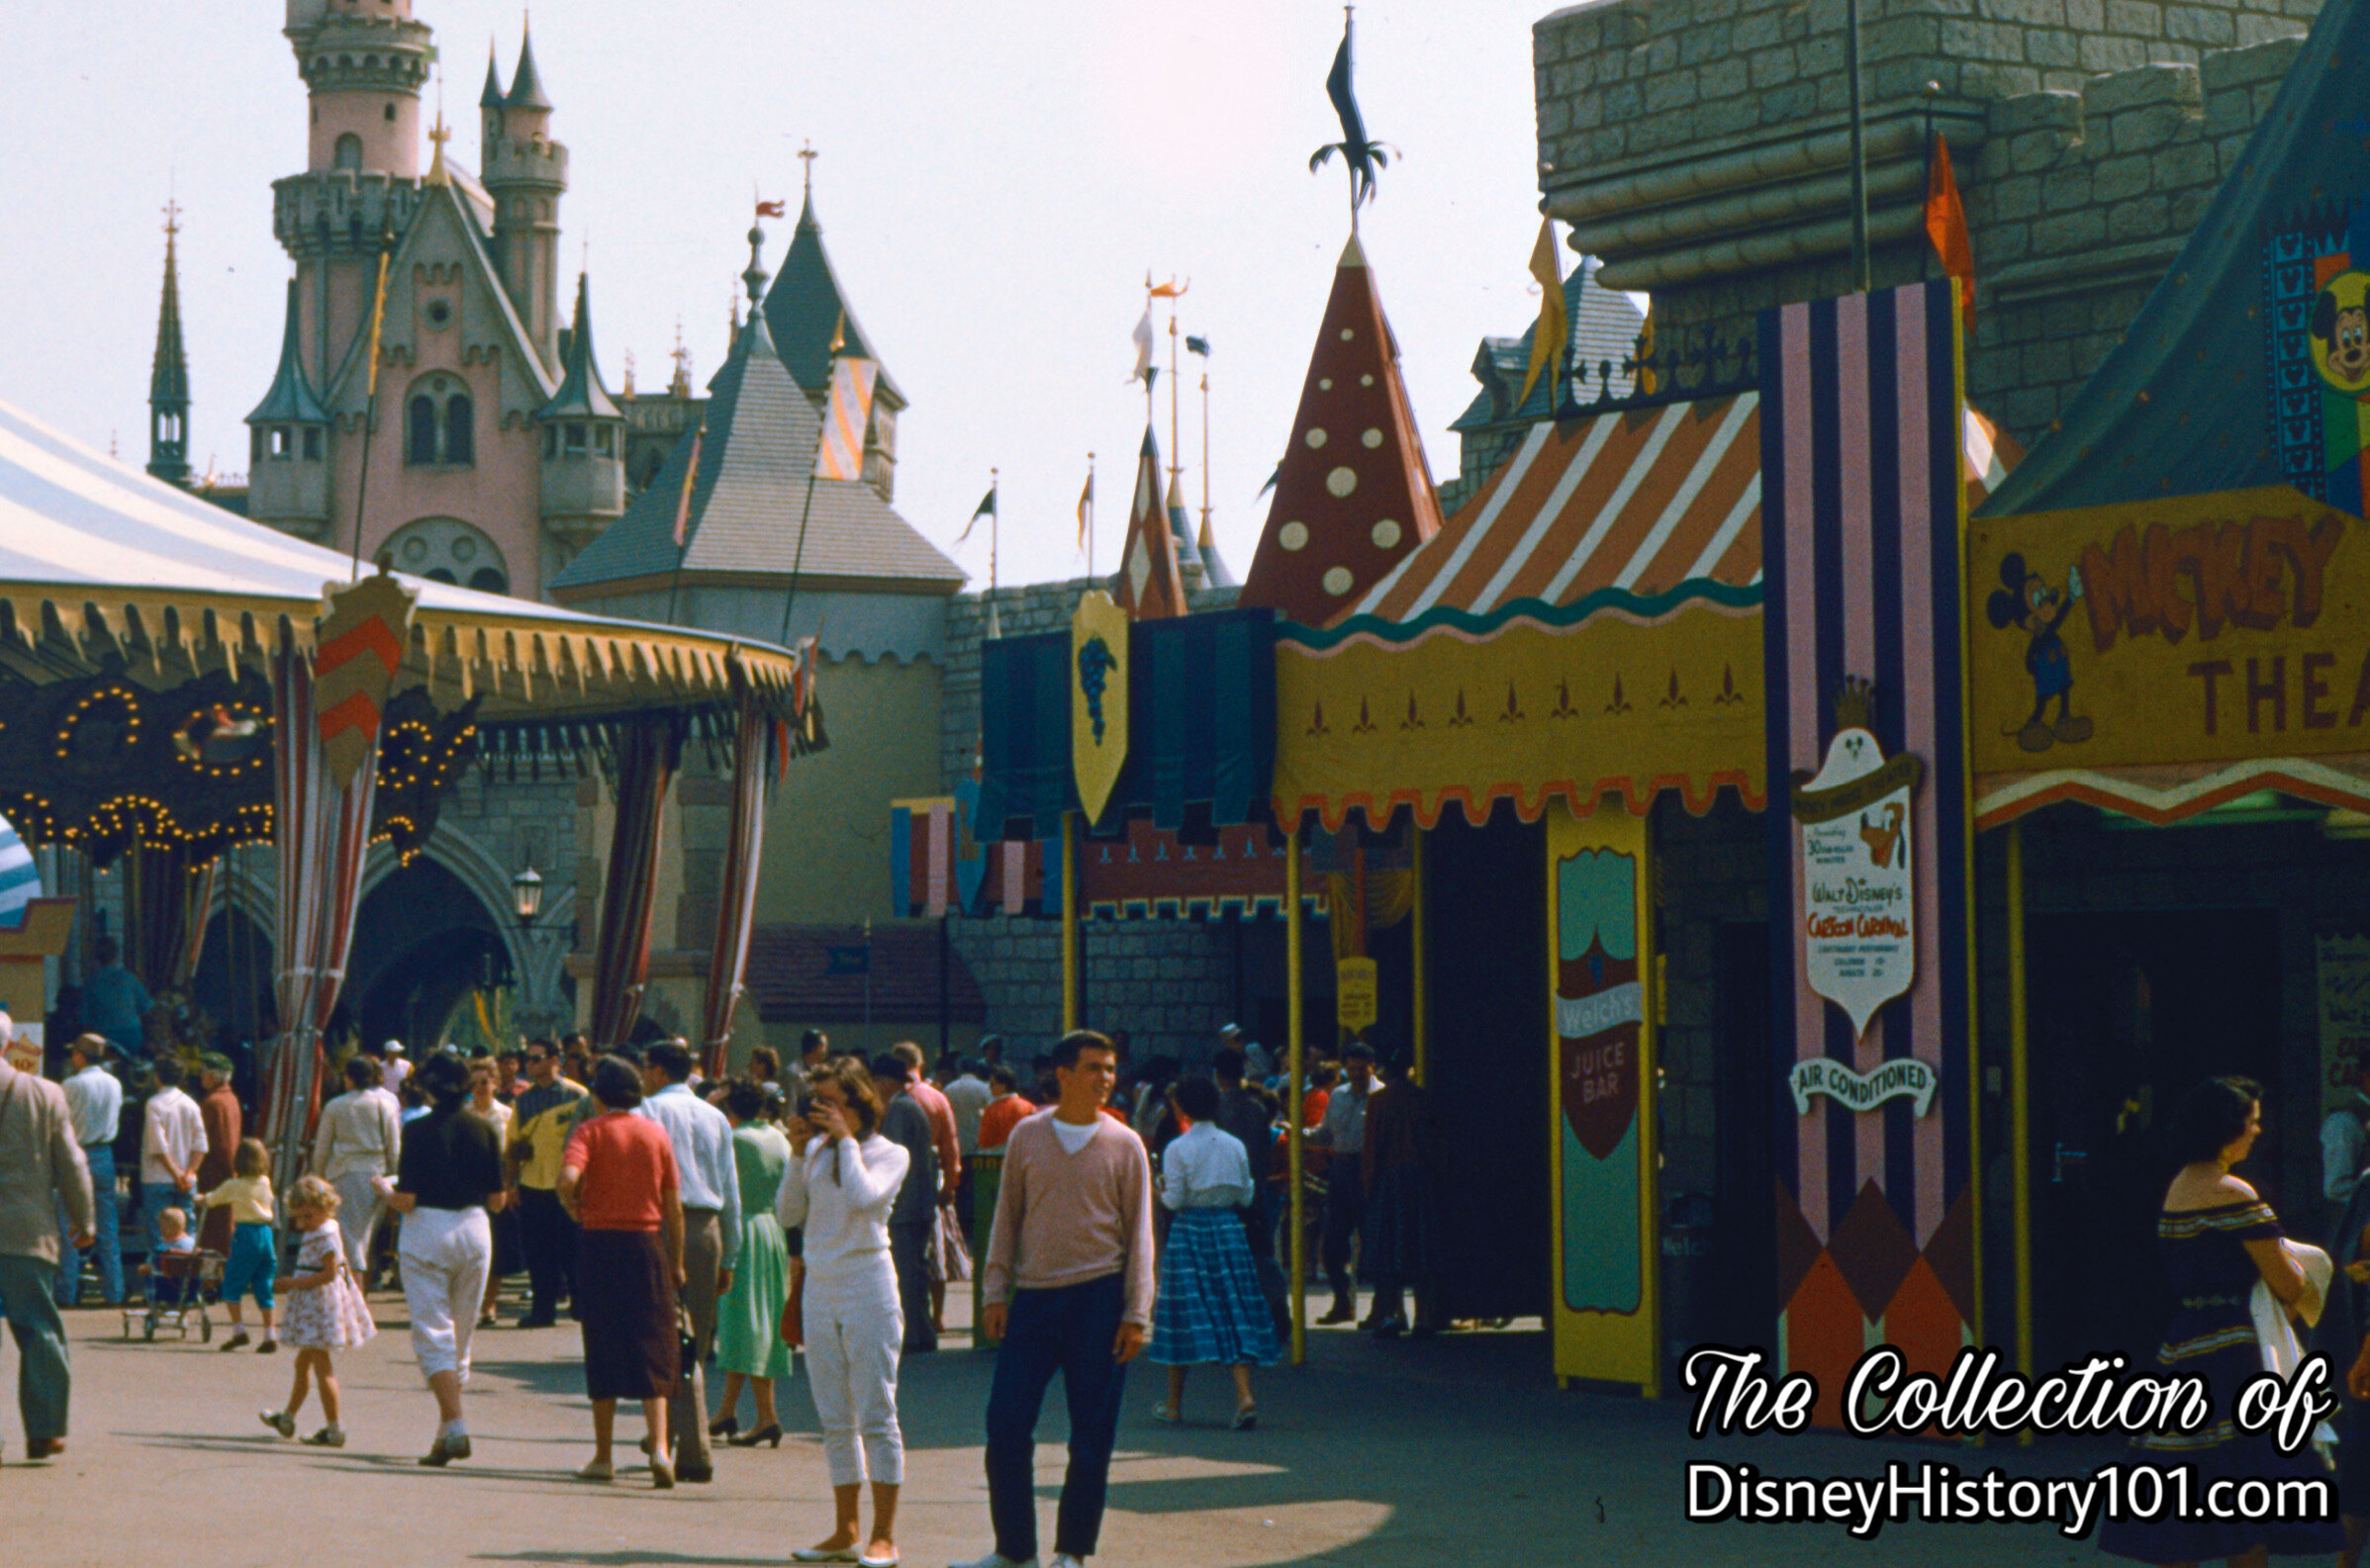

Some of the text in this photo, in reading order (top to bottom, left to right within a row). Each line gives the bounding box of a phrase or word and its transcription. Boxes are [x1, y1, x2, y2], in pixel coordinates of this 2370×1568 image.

[1812, 880, 1845, 903] WALT
[1807, 912, 1854, 939] CARTOON
[1570, 1042, 1625, 1078] JUICE
[1583, 1071, 1618, 1103] BAR
[1799, 1063, 1927, 1103] AIR CONDITIONED
